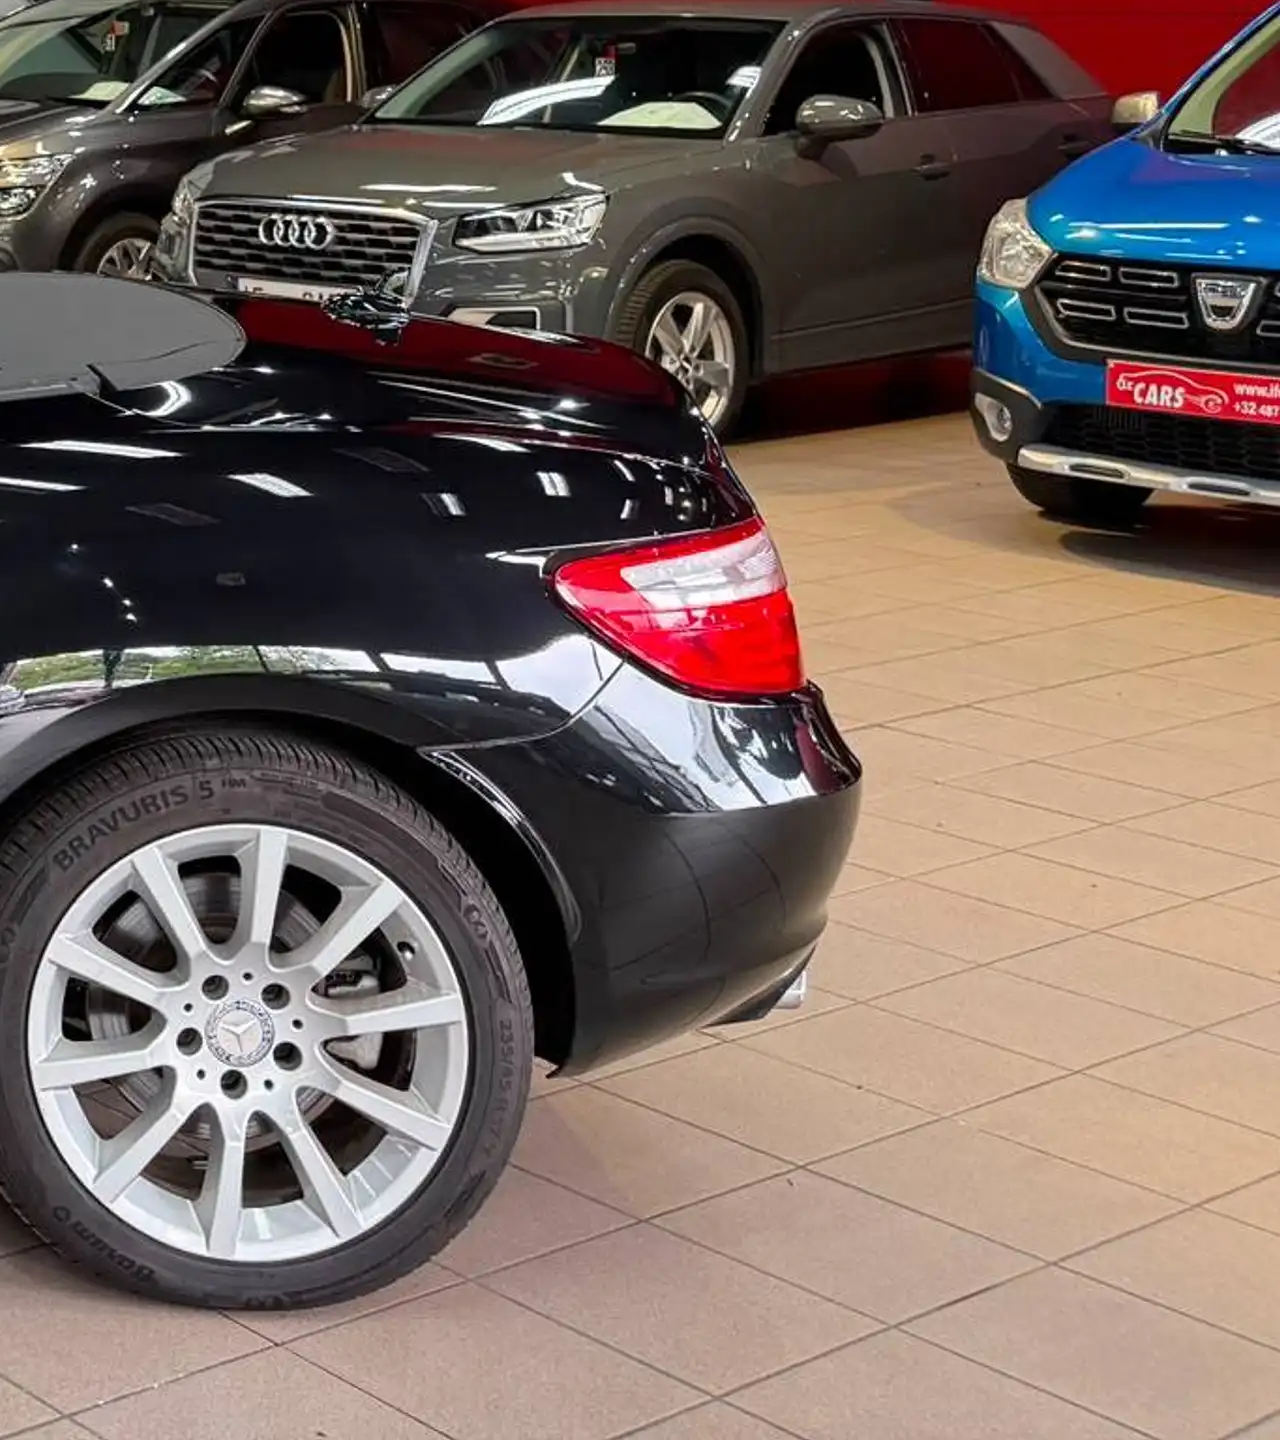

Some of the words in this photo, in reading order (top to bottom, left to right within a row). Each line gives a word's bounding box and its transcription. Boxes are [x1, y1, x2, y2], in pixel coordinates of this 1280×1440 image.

[1133, 381, 1186, 409] CARS
[53, 783, 189, 872] BRAVURIS
[198, 780, 216, 800] 5
